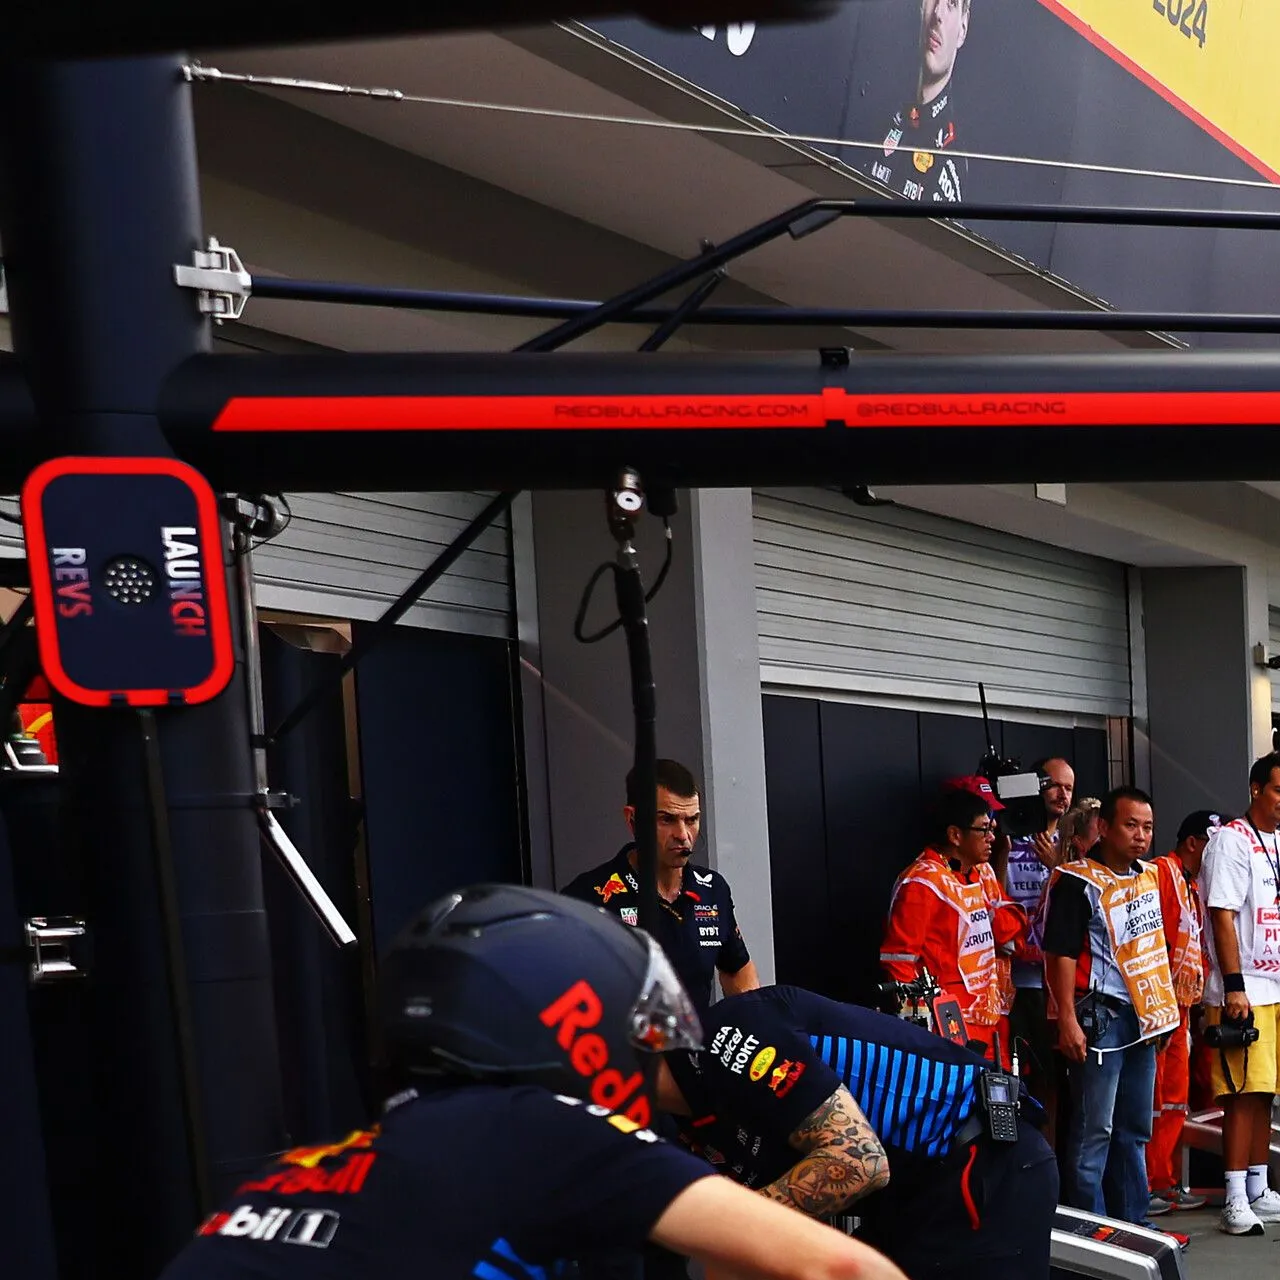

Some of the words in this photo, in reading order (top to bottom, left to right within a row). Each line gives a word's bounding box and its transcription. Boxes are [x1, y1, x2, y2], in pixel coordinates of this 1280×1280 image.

[555, 404, 807, 418] REDBULLRACING.COM
[857, 401, 1066, 417] @REDBULLRACING
[52, 548, 94, 618] REVS
[161, 527, 206, 636] LAUNCH
[539, 979, 644, 1110] Red
[710, 1025, 733, 1056] VISA
[730, 1034, 760, 1075] ROKT
